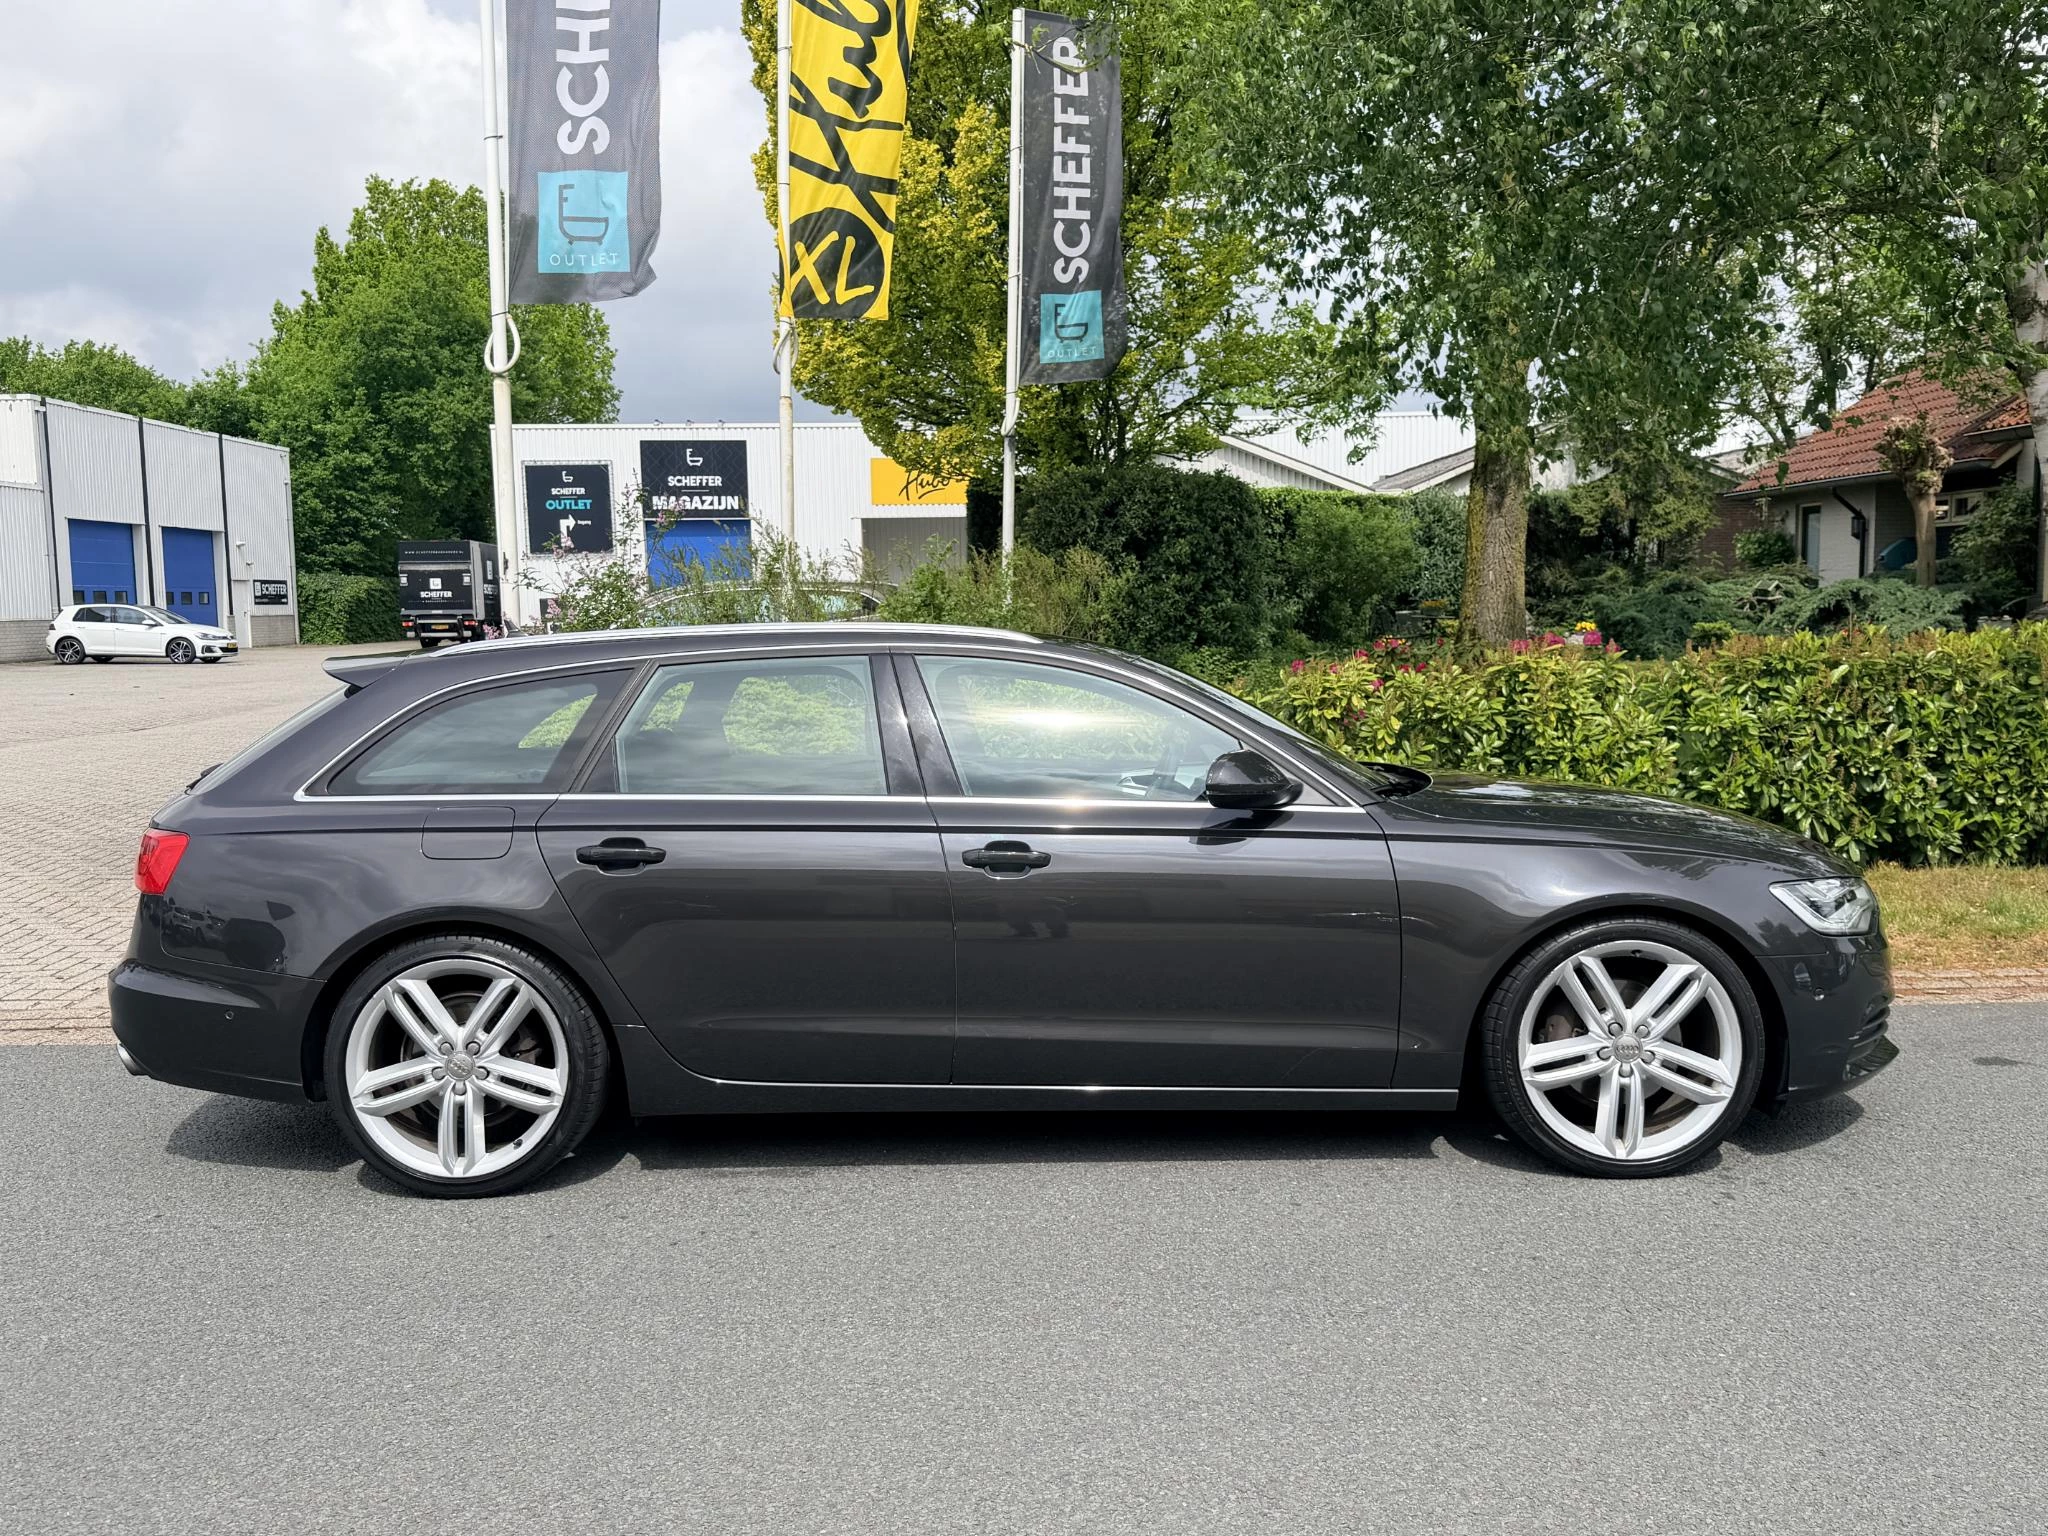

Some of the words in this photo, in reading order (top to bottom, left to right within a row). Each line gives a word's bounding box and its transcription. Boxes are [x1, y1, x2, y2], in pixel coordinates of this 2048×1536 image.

[1053, 37, 1091, 284] SCHEFFER
[549, 252, 618, 266] OUTLET
[788, 230, 875, 305] XL
[1047, 346, 1097, 358] OUTLET
[667, 475, 723, 487] SCHEFFER
[551, 487, 586, 495] SCHEFFER
[545, 499, 592, 510] OUTLET
[652, 495, 739, 510] MAGAZIJN
[262, 583, 287, 595] SCHEFFER
[420, 590, 453, 598] SCHEFFER
